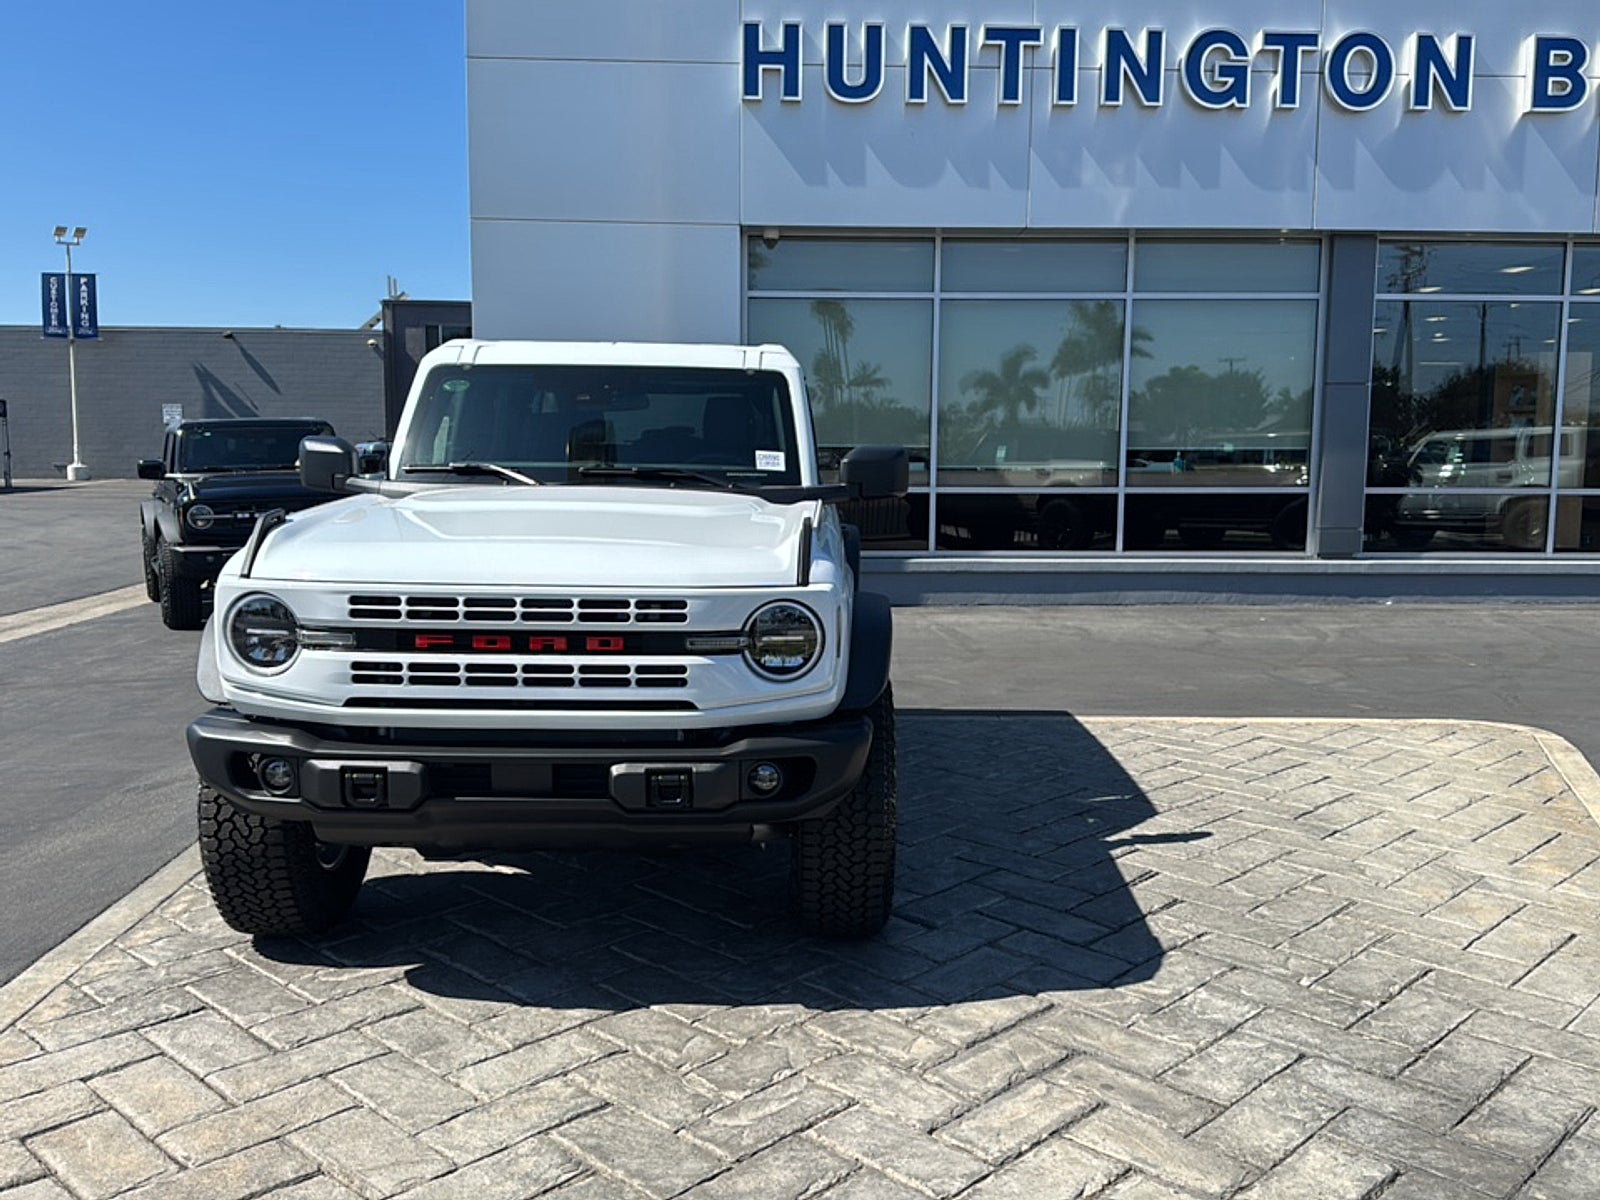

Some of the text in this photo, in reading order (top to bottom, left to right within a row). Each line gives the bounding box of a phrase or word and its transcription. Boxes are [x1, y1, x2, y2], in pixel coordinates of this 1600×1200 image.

[741, 21, 1589, 112] HUNTINGTON B
[79, 277, 90, 327] PARKING
[414, 634, 625, 651] FORD
